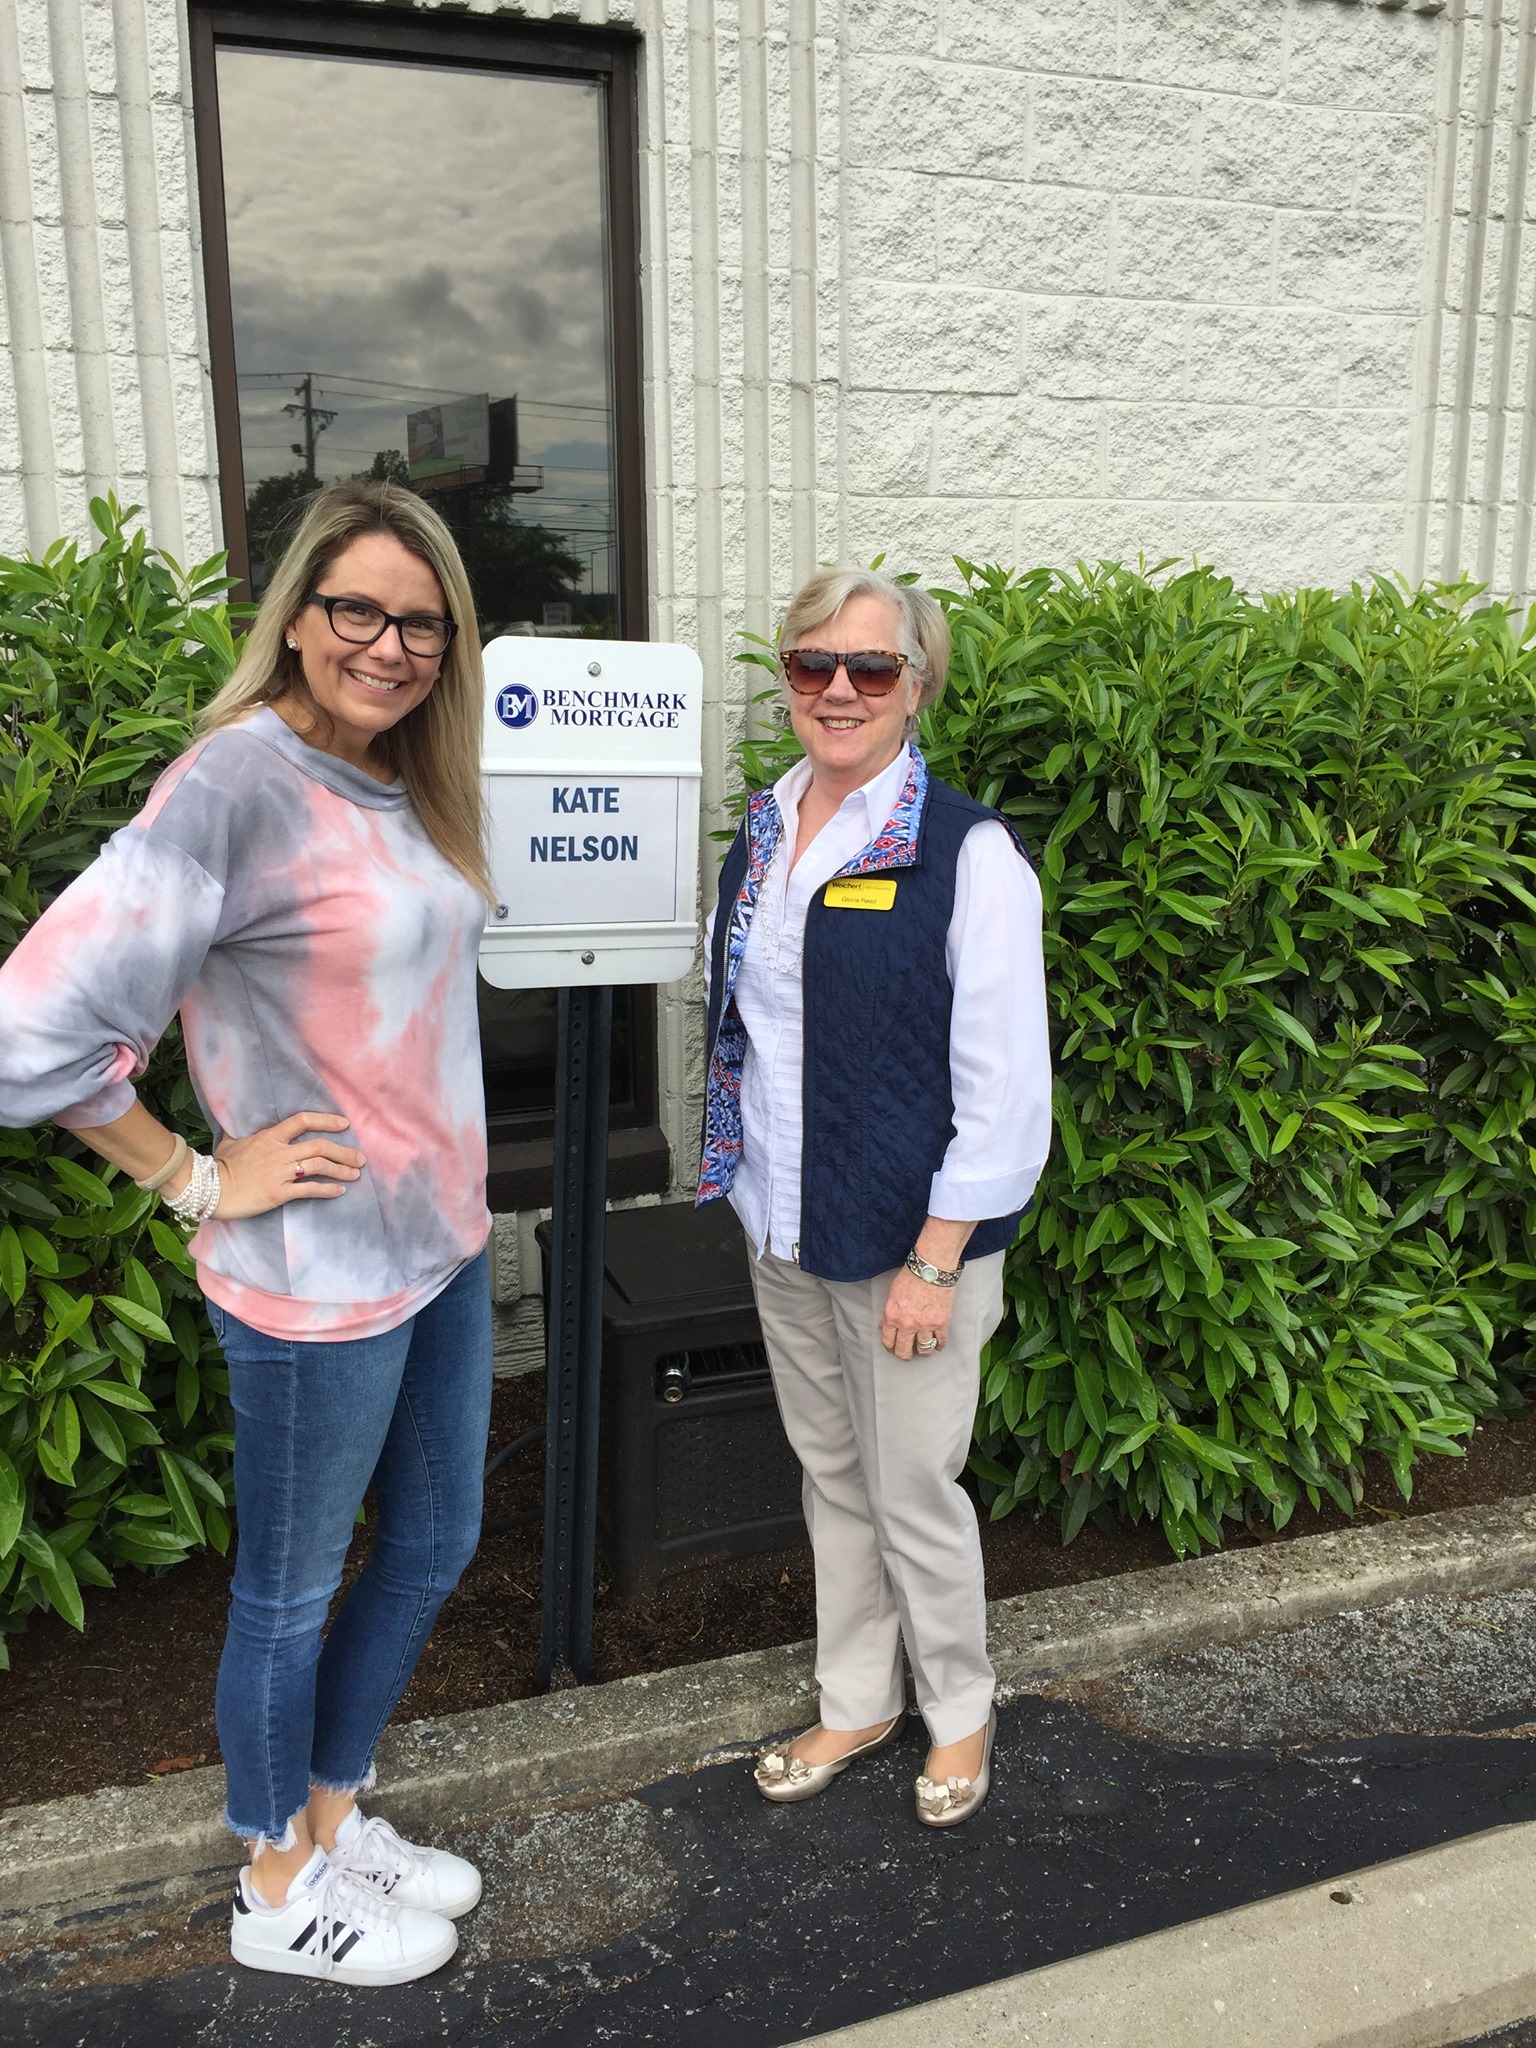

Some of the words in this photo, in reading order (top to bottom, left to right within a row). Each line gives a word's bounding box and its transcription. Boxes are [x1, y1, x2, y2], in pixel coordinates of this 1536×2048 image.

[542, 689, 688, 710] BENCHMARK
[550, 709, 679, 728] MORTGAGE
[552, 787, 619, 813] KATE
[530, 835, 638, 862] NELSON
[309, 1862, 328, 1886] adidas
